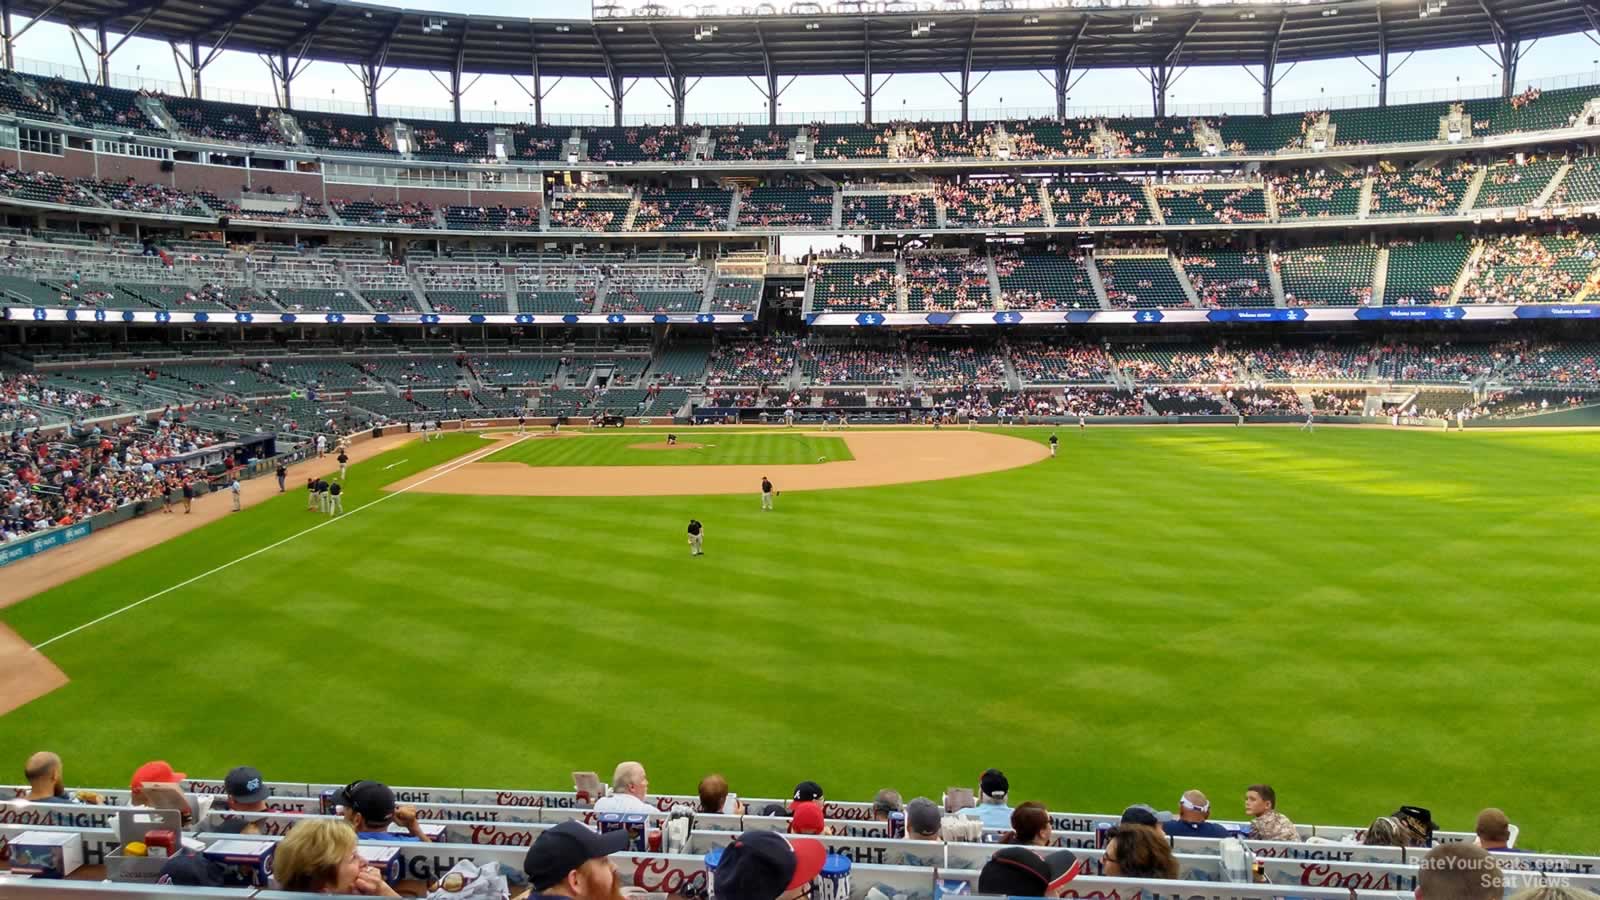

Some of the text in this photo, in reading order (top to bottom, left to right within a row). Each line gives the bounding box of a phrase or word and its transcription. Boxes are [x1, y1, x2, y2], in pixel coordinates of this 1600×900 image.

[396, 792, 430, 803] IGHT
[496, 792, 576, 808] Coors LIGH
[823, 803, 872, 820] Coors
[1055, 819, 1092, 832] IGHT
[470, 824, 532, 847] Coor
[632, 857, 707, 893] Coo
[1300, 863, 1392, 890] Coors
